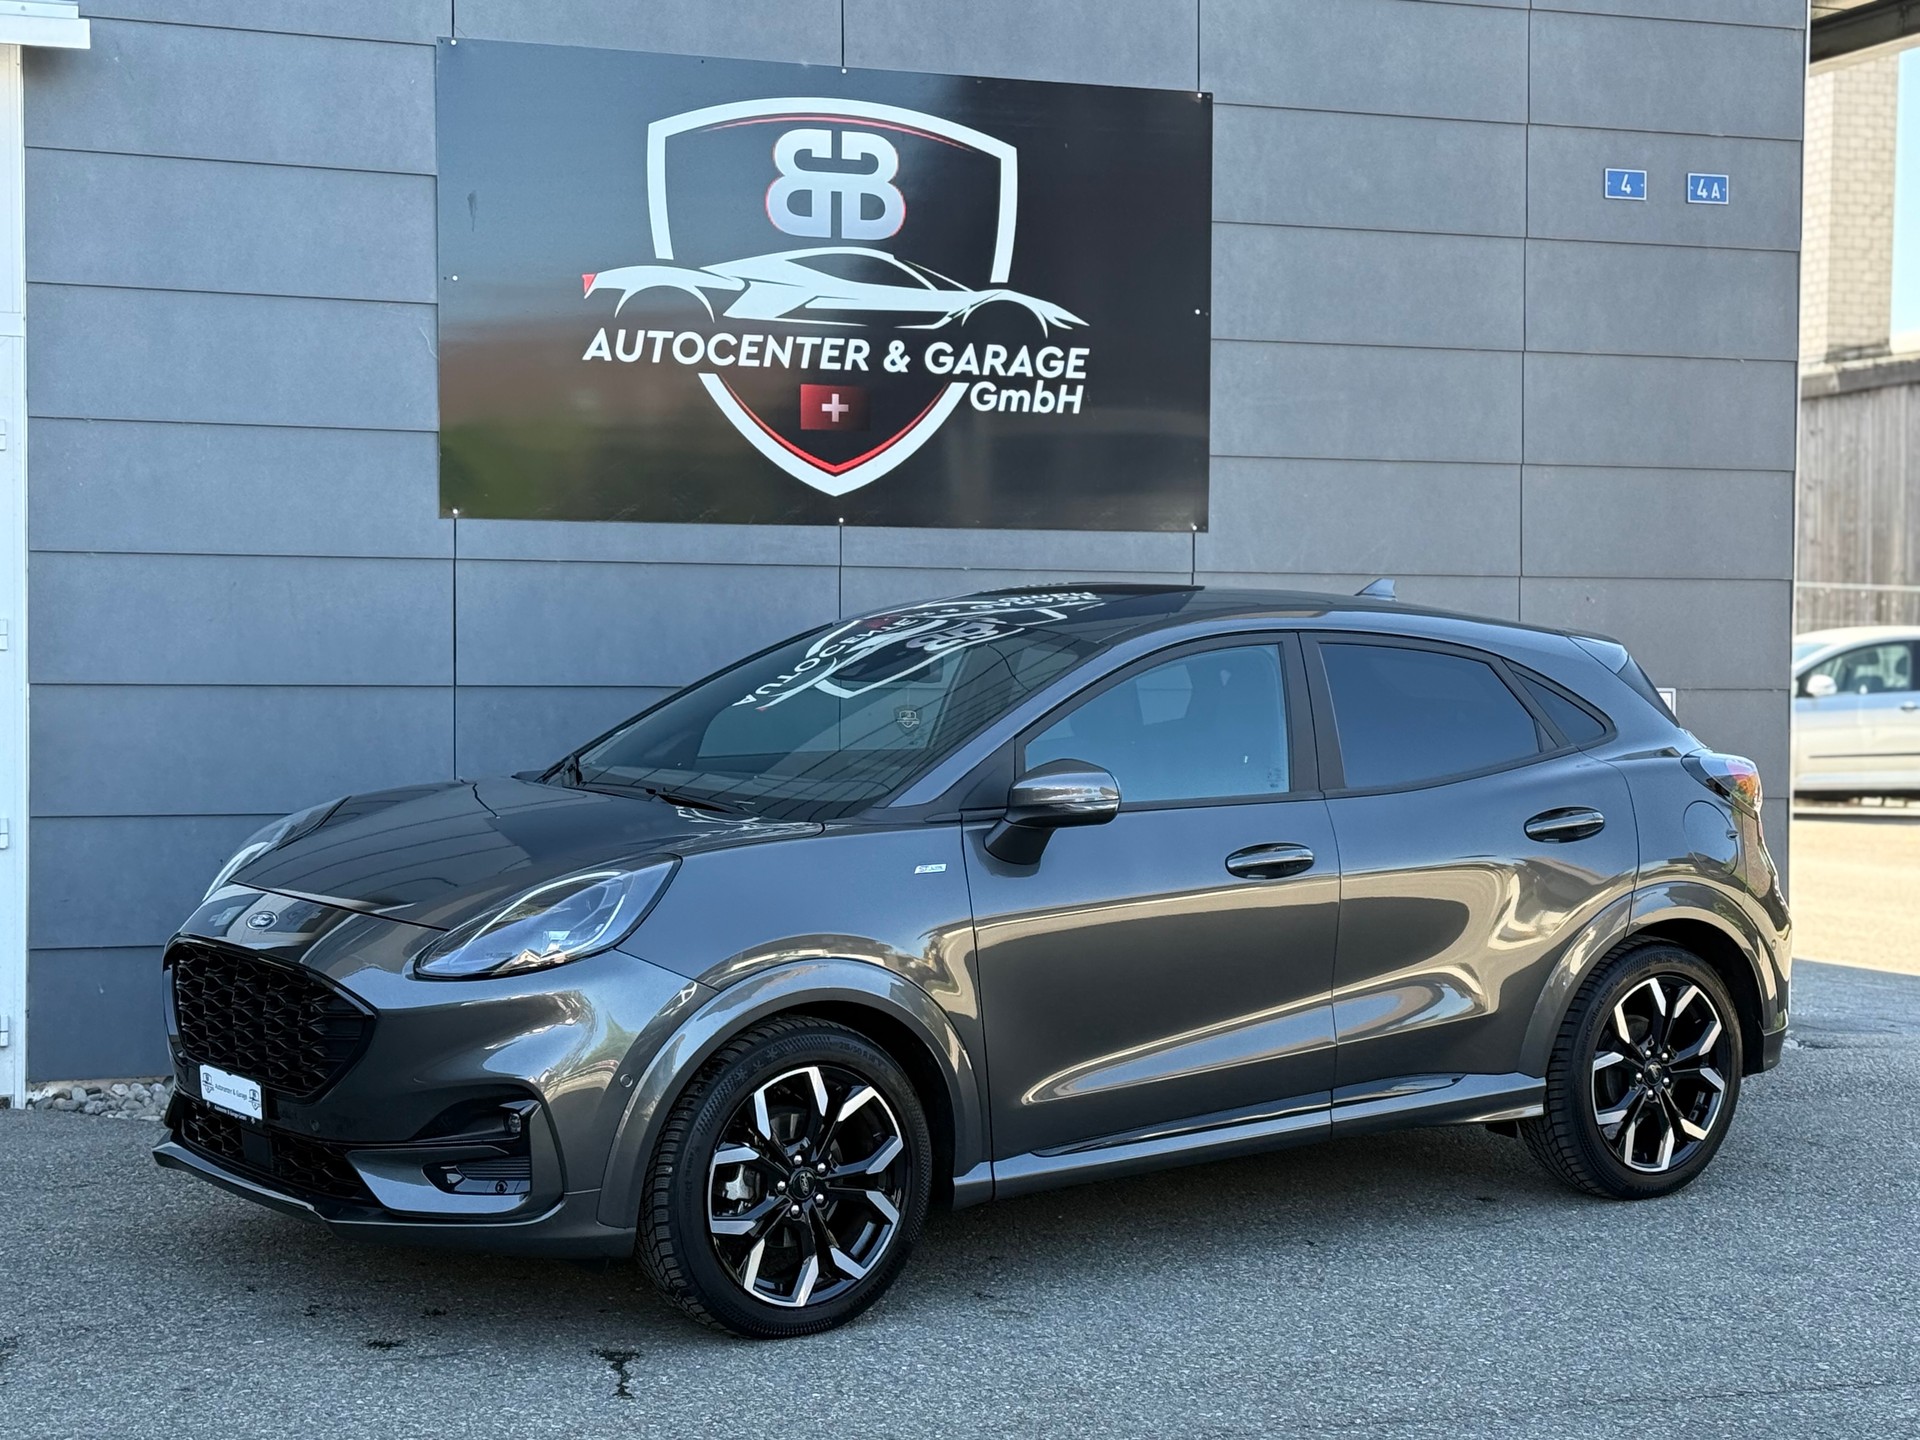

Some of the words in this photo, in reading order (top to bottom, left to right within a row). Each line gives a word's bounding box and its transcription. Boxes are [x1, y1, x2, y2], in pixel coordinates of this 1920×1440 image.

[1620, 173, 1632, 194] 4
[582, 326, 871, 371] AUTOCENTER
[883, 340, 910, 373] &
[924, 342, 1091, 379] GARAGE
[970, 381, 1085, 414] GmbH
